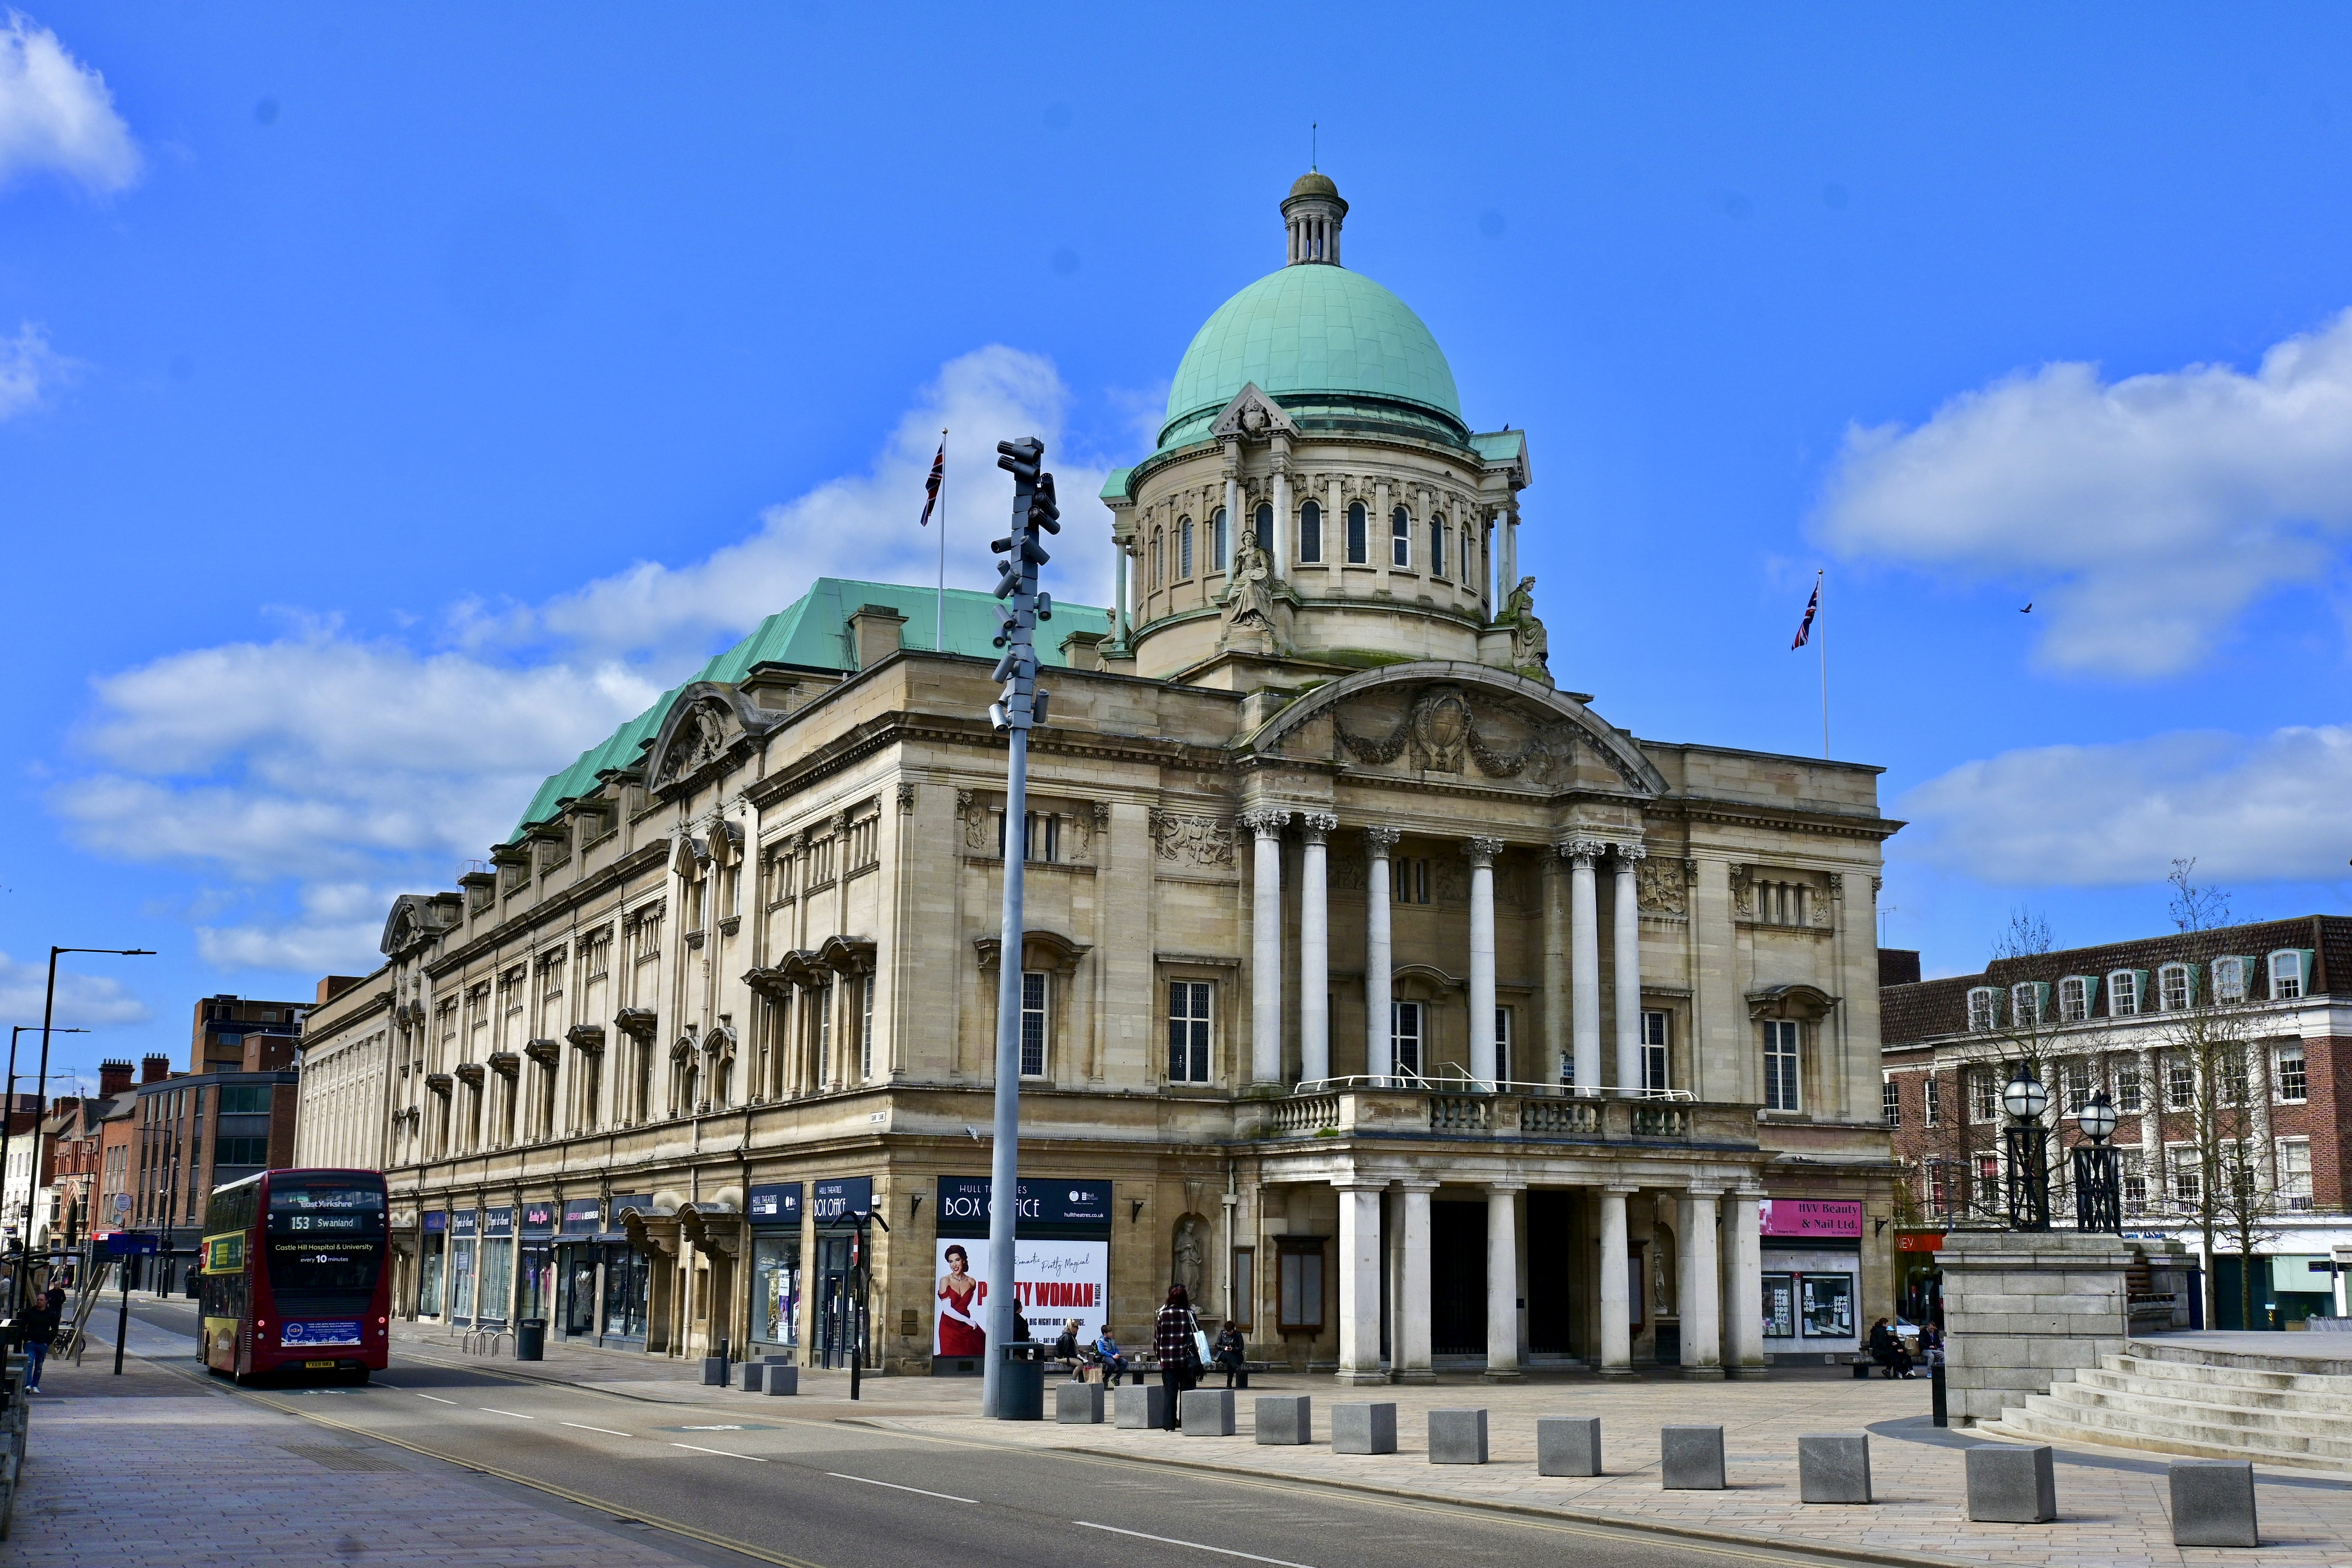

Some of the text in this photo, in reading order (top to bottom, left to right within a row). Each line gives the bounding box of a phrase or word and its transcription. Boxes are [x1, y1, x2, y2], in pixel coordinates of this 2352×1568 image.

[960, 1184, 981, 1193] HULL
[761, 1195, 777, 1204] THEATRES
[814, 1199, 826, 1217] BOX
[827, 1198, 846, 1216] OFFICE
[945, 1197, 1040, 1217] BOX FICE
[1822, 1204, 1857, 1217] Beauty
[291, 1216, 353, 1230] 153 Swanland
[1802, 1219, 1858, 1229] & Nail Ltd.
[1014, 1252, 1090, 1277] Romantic Pretty Magical
[977, 1281, 1093, 1307] PTY WOMAN
